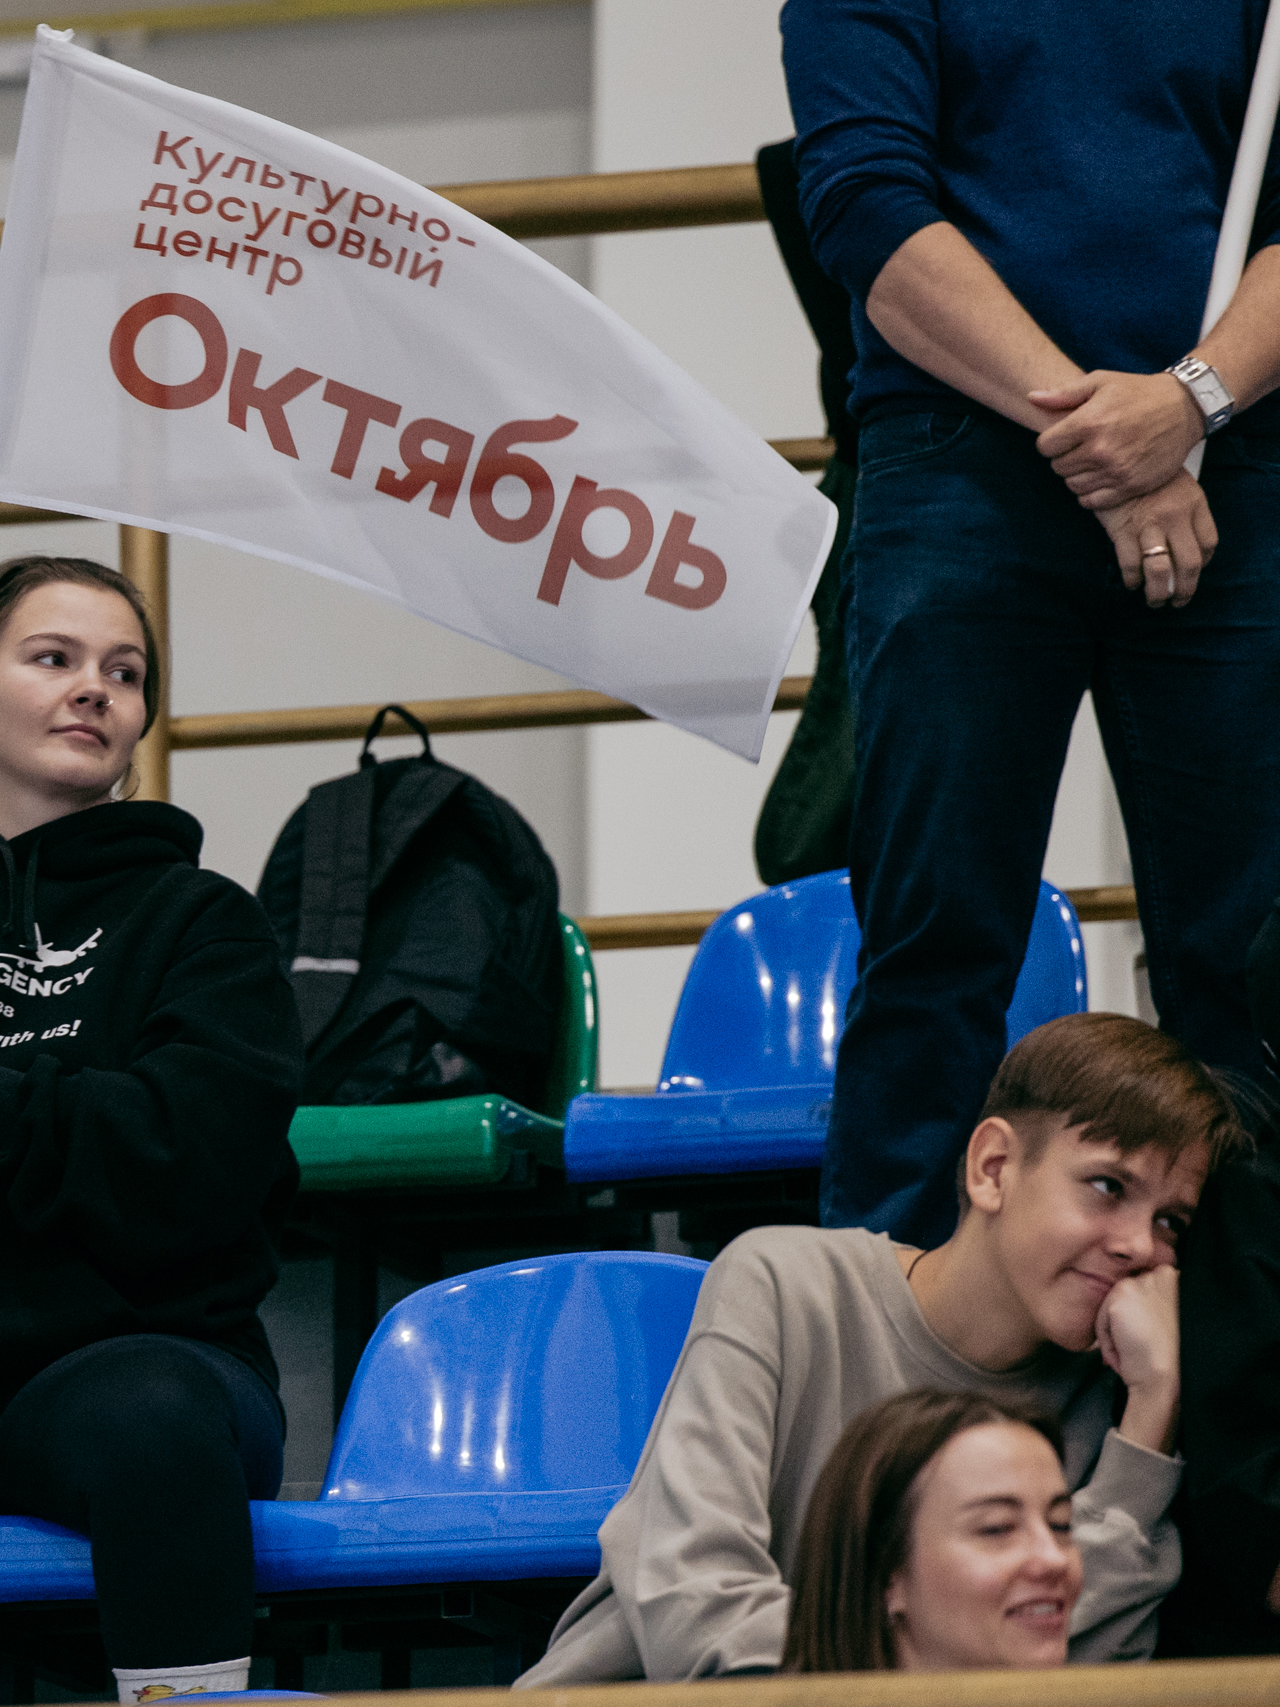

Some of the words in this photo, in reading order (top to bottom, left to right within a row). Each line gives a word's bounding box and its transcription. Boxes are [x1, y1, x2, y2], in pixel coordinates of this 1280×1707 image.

[140, 181, 444, 288] досуговый
[152, 130, 477, 250] Культурно-
[133, 222, 304, 296] центр
[109, 292, 728, 612] Октябрь
[40, 1019, 82, 1040] us!
